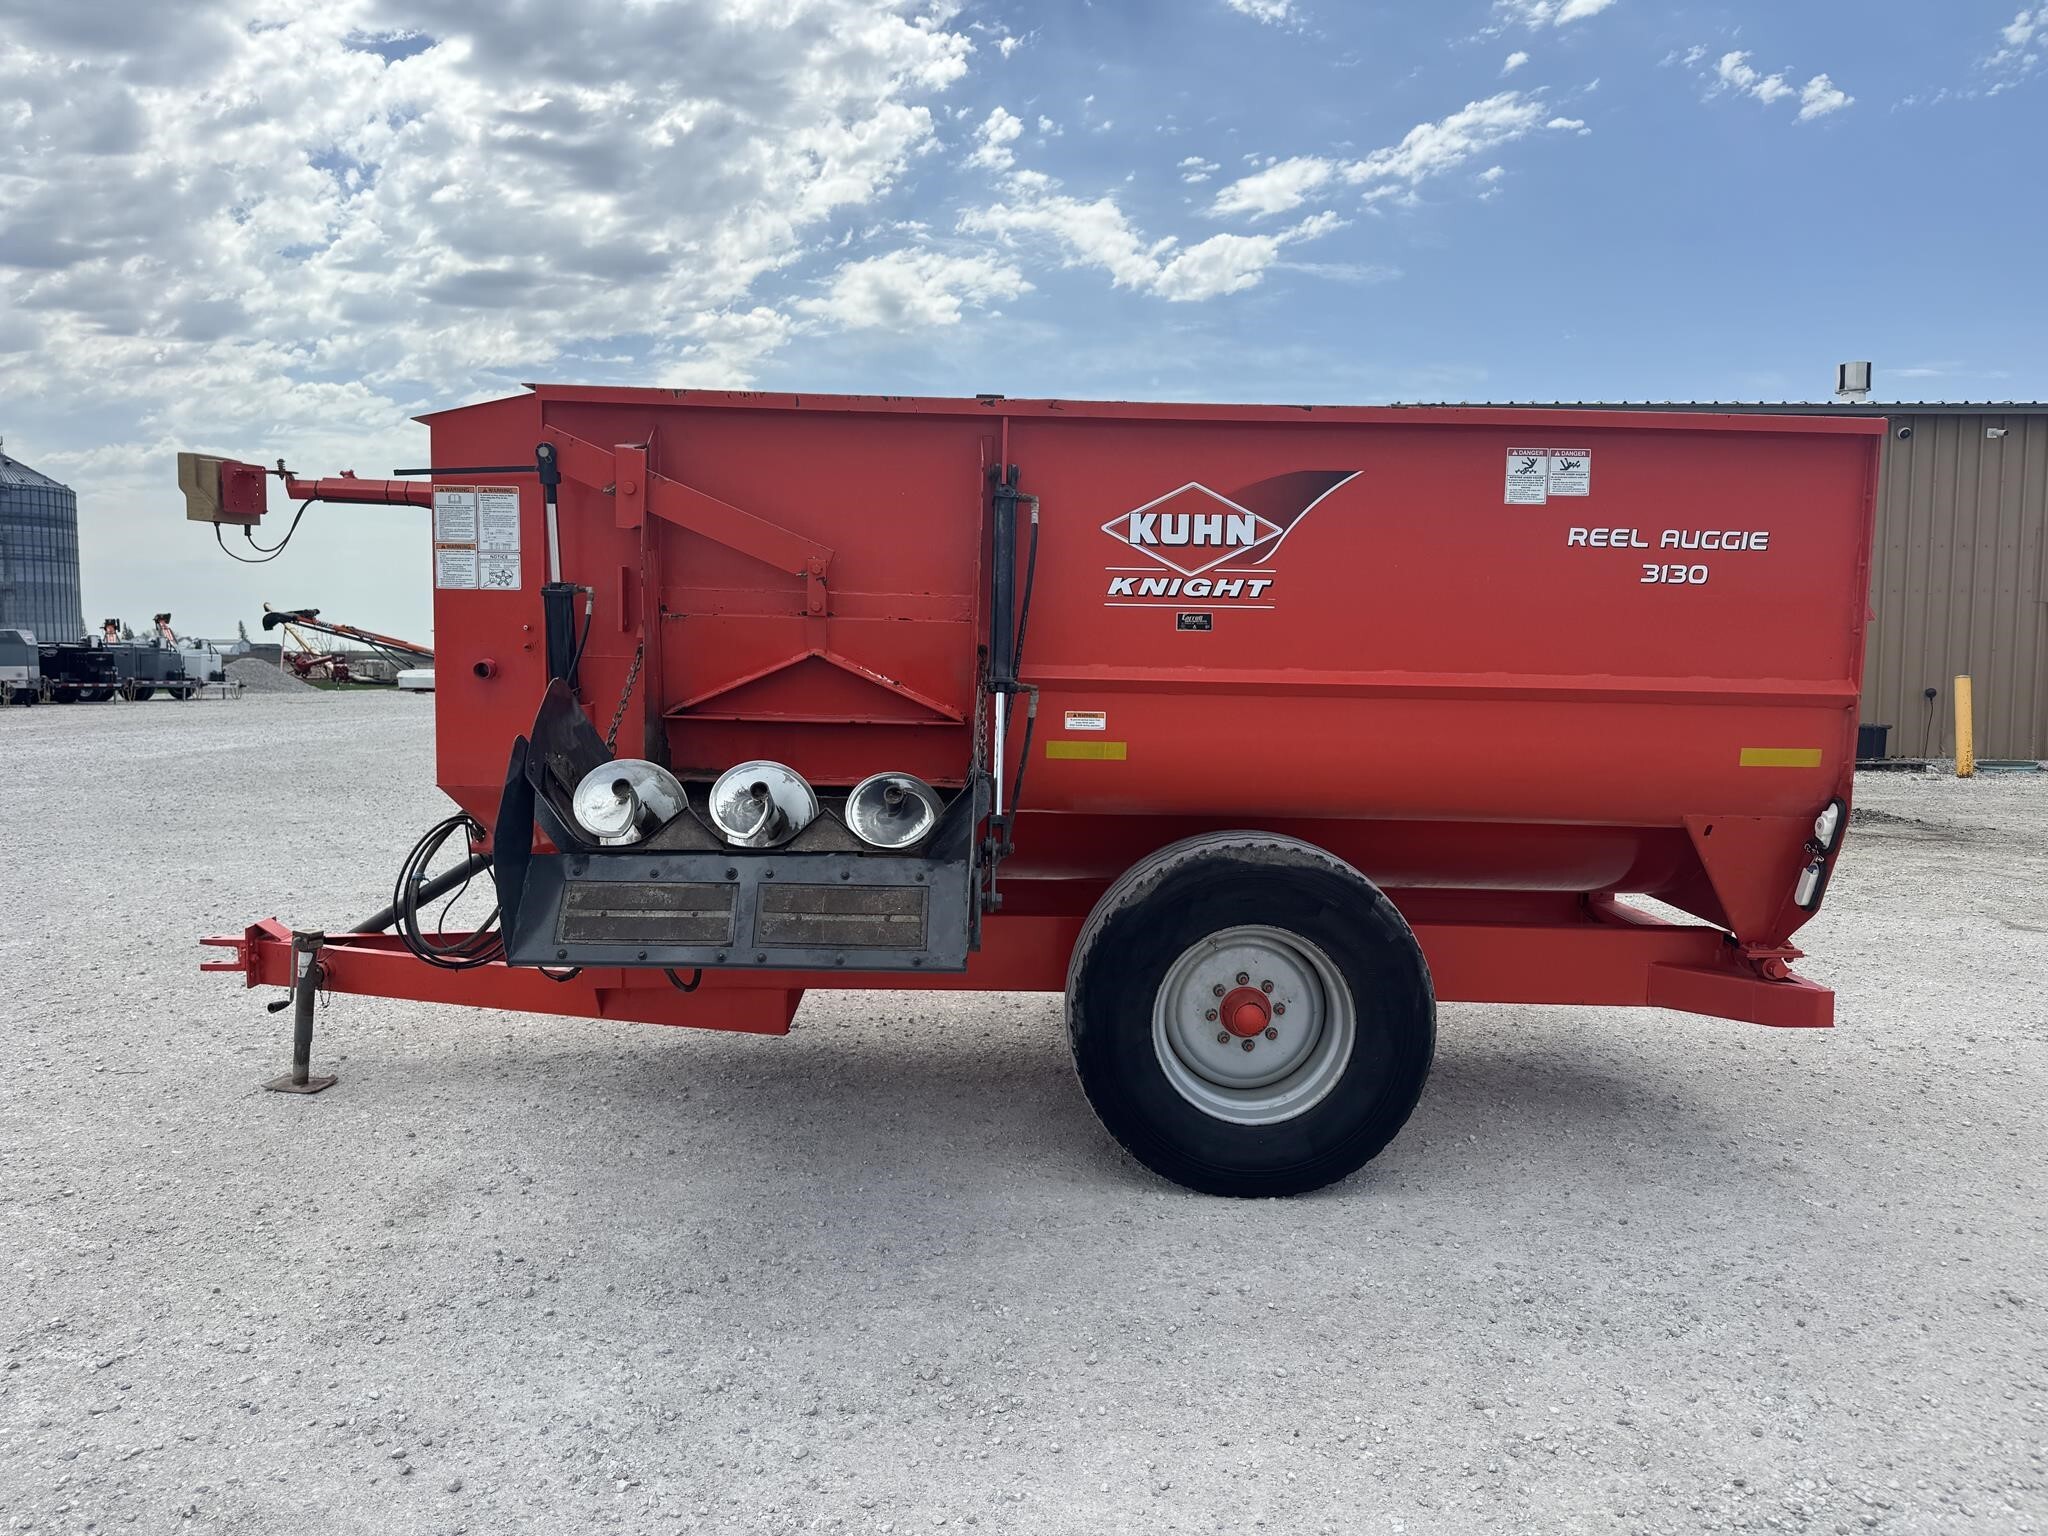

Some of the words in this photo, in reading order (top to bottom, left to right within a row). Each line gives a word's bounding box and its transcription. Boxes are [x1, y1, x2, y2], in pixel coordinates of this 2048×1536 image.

[1129, 513, 1256, 546] KUHN
[1567, 527, 1649, 548] REEL
[1660, 529, 1770, 550] AUGGIE
[1640, 564, 1709, 584] 3130
[1107, 577, 1272, 598] KNIGHT
